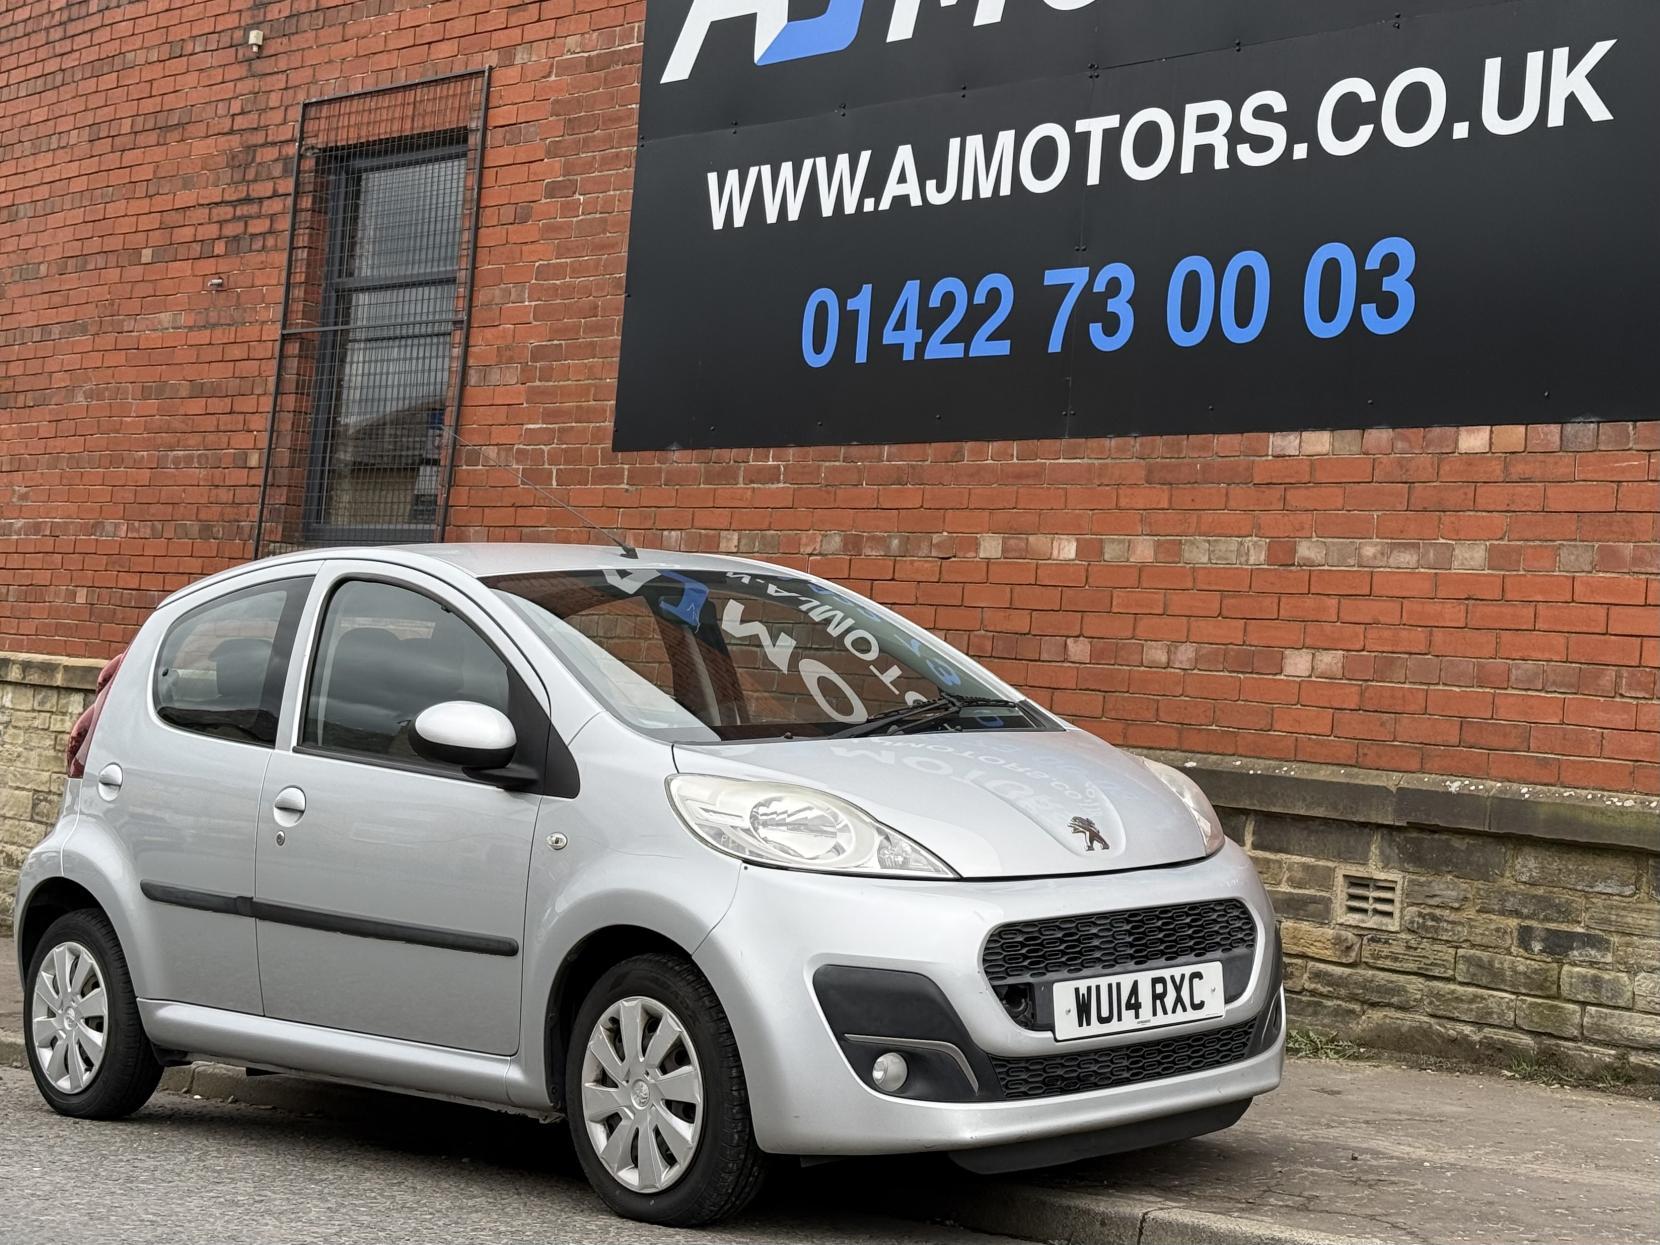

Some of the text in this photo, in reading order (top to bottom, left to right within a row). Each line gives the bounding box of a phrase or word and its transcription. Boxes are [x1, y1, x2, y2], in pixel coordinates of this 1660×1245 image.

[707, 39, 1618, 230] WWW.AJMOTORS.CO.UK
[802, 236, 1417, 368] 01422 73 00 03
[1074, 971, 1205, 1028] WU14 RXC
